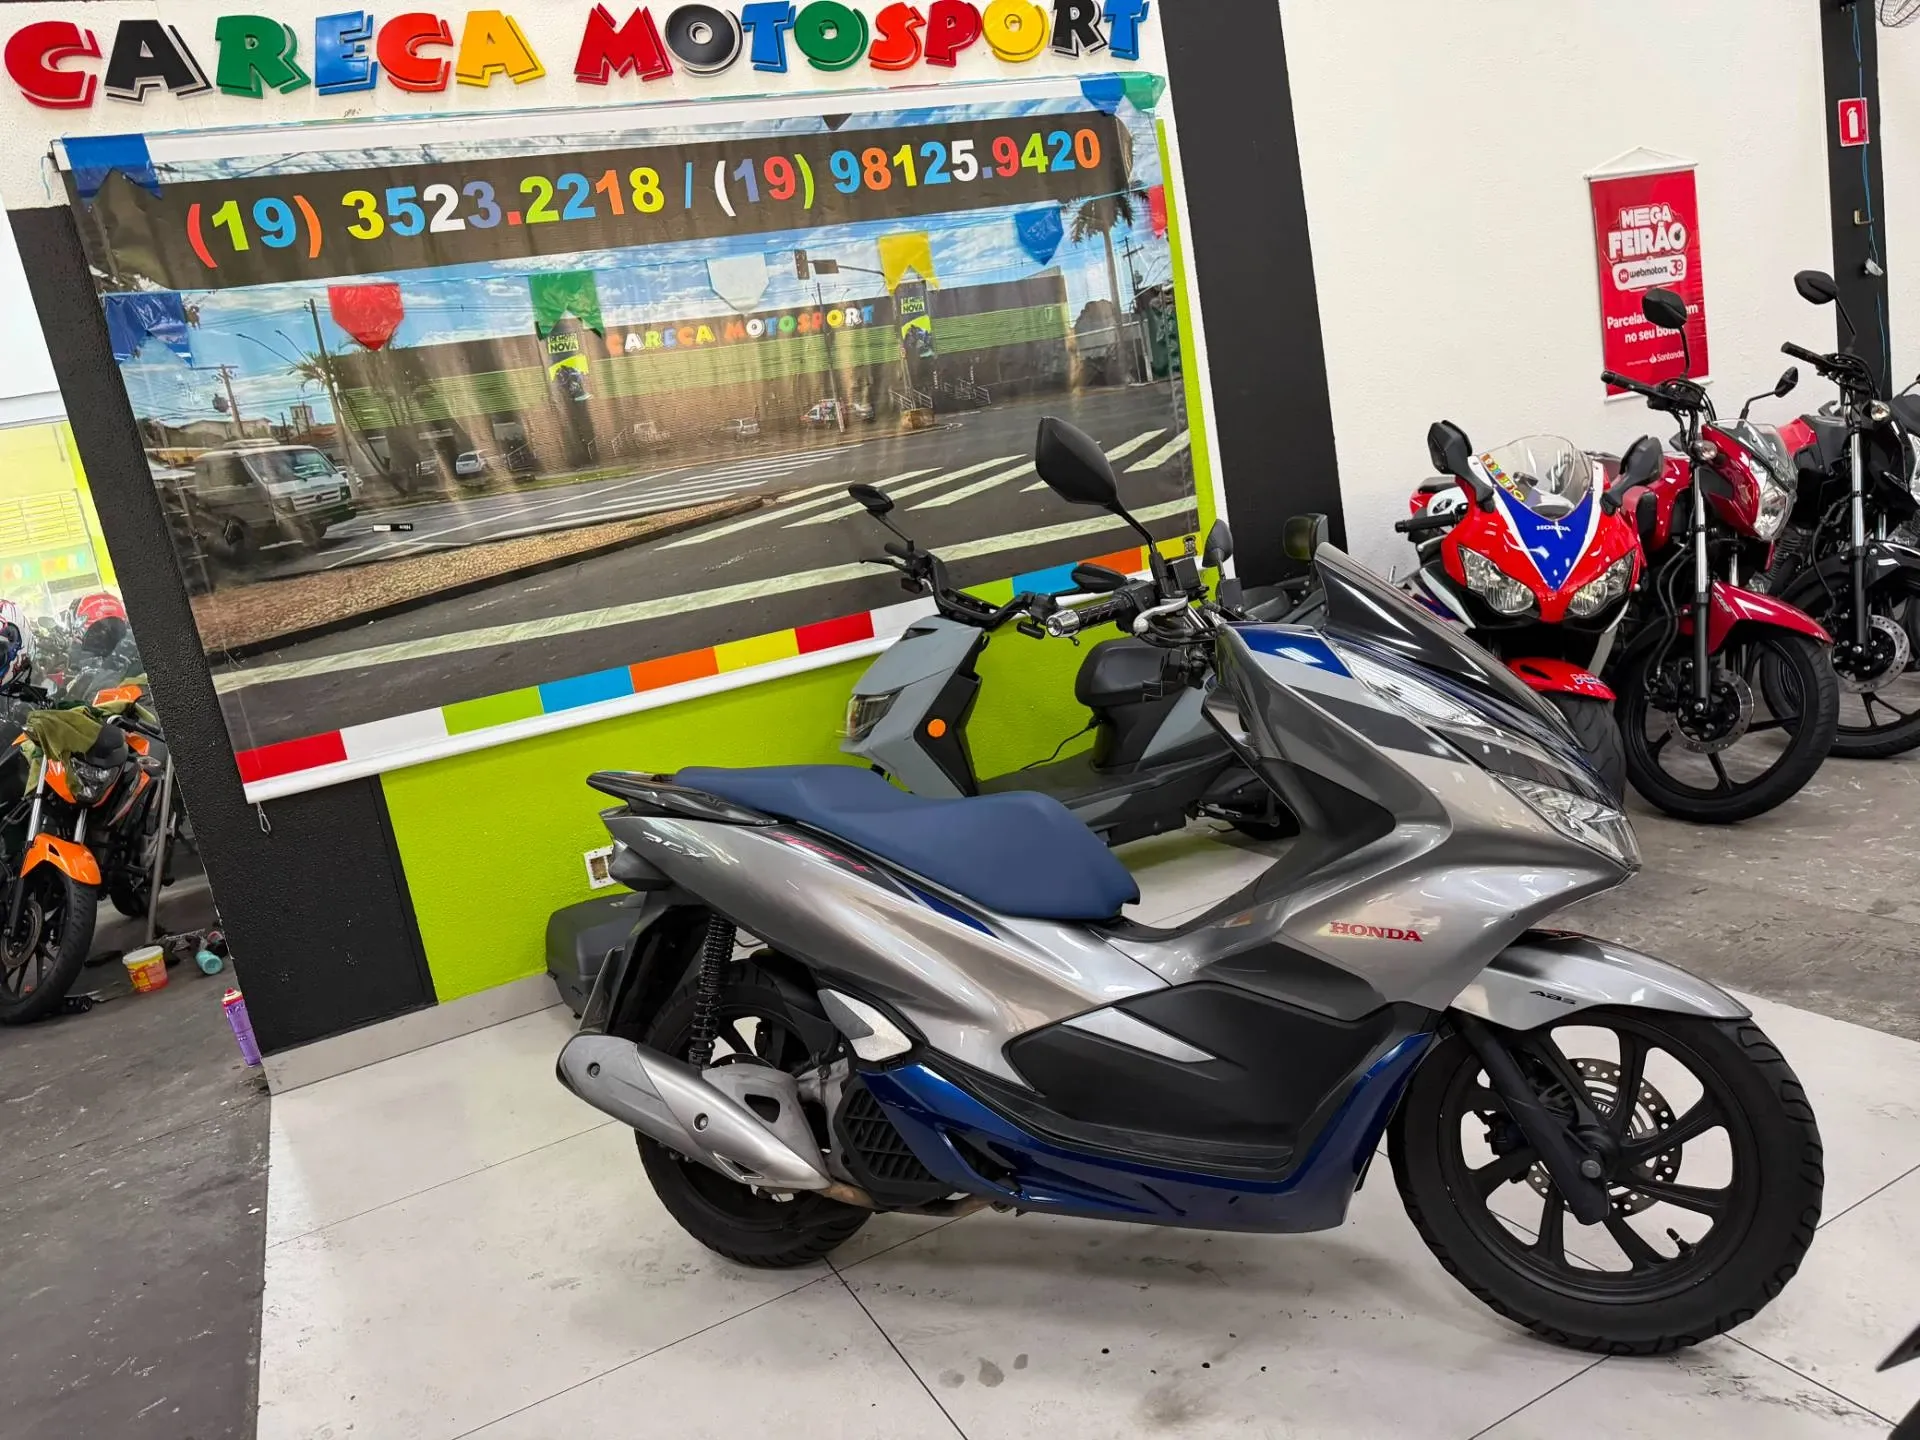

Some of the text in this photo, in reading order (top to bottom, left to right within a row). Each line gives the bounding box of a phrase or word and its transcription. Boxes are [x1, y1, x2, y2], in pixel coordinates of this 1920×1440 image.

[4, 0, 1148, 109] CARECA MOTOSPORT
[187, 128, 1100, 268] (19) 3523.2218 / (19) 98125.9420
[1621, 205, 1672, 229] MEGA
[1608, 221, 1686, 259] FEIRÃO
[1630, 266, 1668, 278] webmotors
[903, 303, 923, 312] NOVA
[606, 305, 874, 357] CARECA MOTOSPORT
[1625, 332, 1637, 343] no
[1639, 328, 1655, 341] seu
[550, 342, 577, 352] NOVA
[1657, 350, 1685, 362] Santande
[1330, 921, 1423, 942] HONDA
[1529, 990, 1576, 1004] ABS
